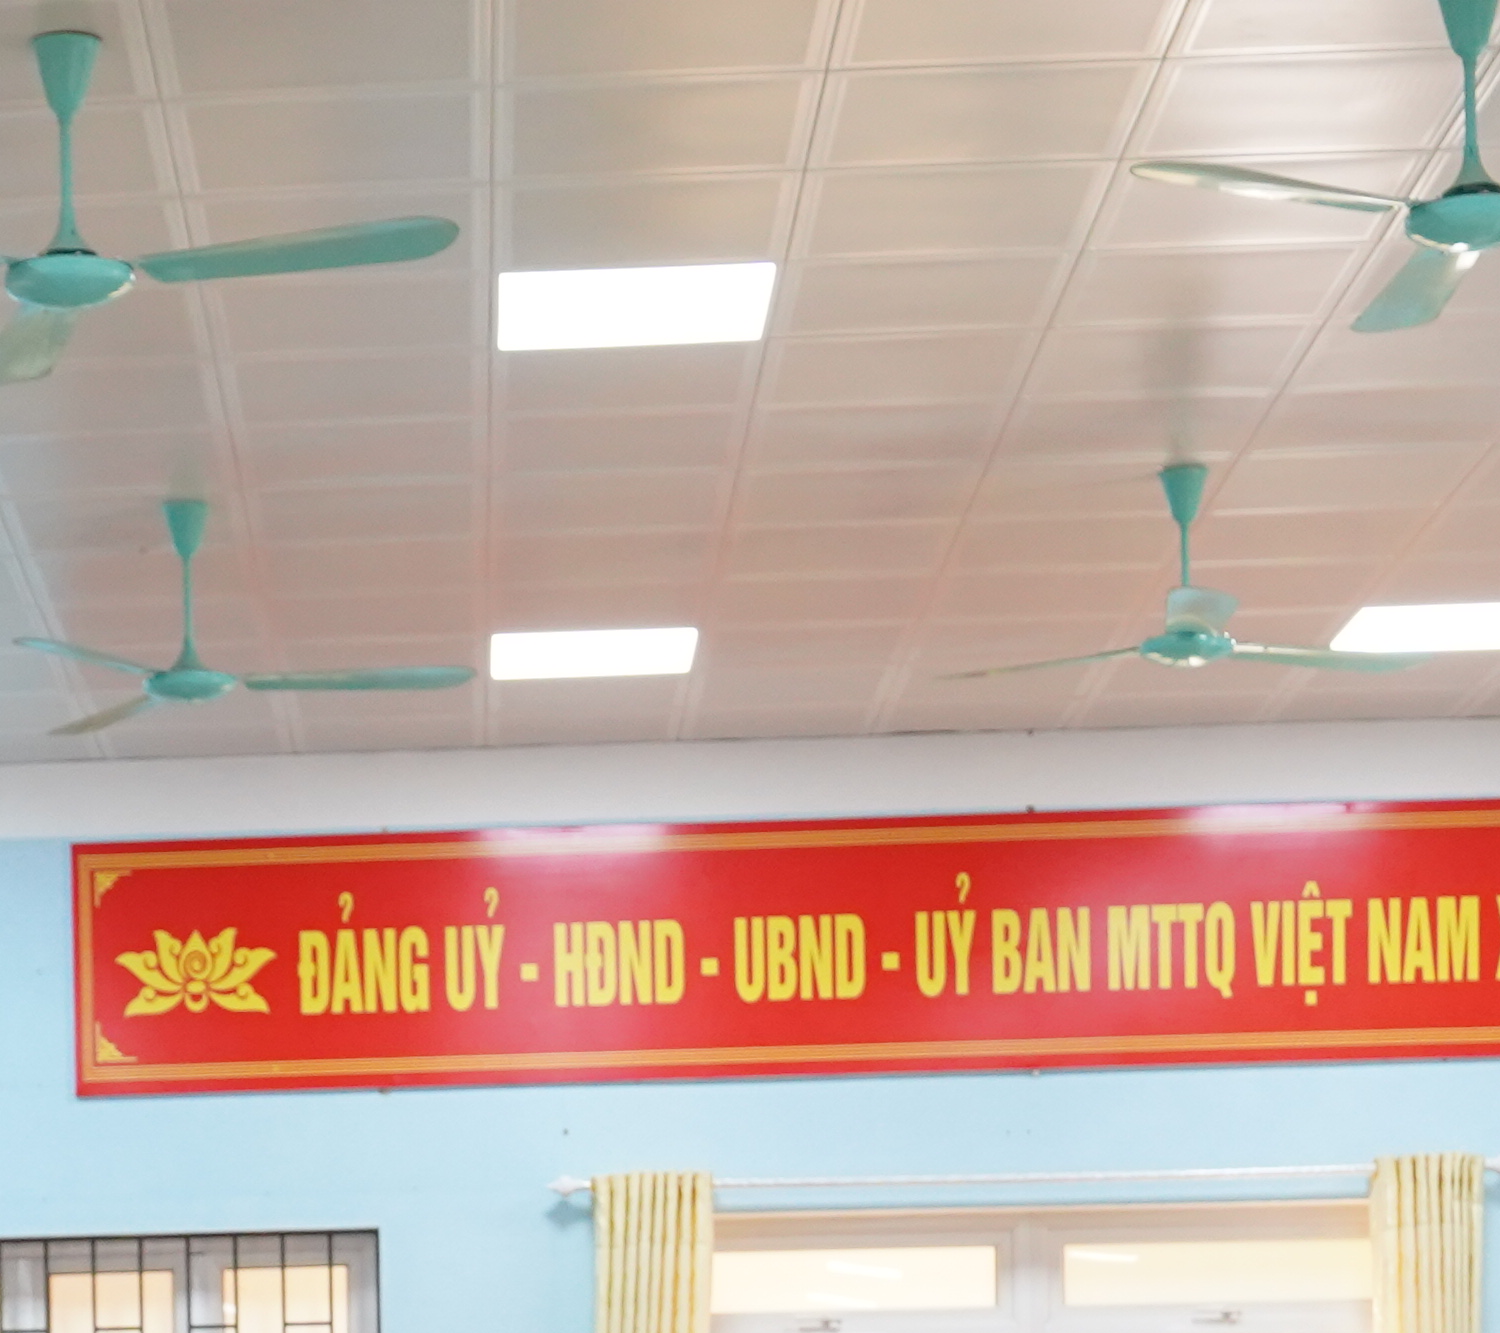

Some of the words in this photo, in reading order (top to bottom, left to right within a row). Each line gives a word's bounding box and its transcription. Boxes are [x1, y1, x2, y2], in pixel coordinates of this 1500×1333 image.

[297, 891, 430, 1015] ĐẢNG
[553, 919, 686, 1008] HĐND
[733, 912, 866, 1003] UBND
[991, 905, 1092, 995] BAN
[1106, 901, 1238, 999] MTTQ
[1249, 880, 1354, 1006] VIỆT
[1367, 895, 1481, 984] NAM
